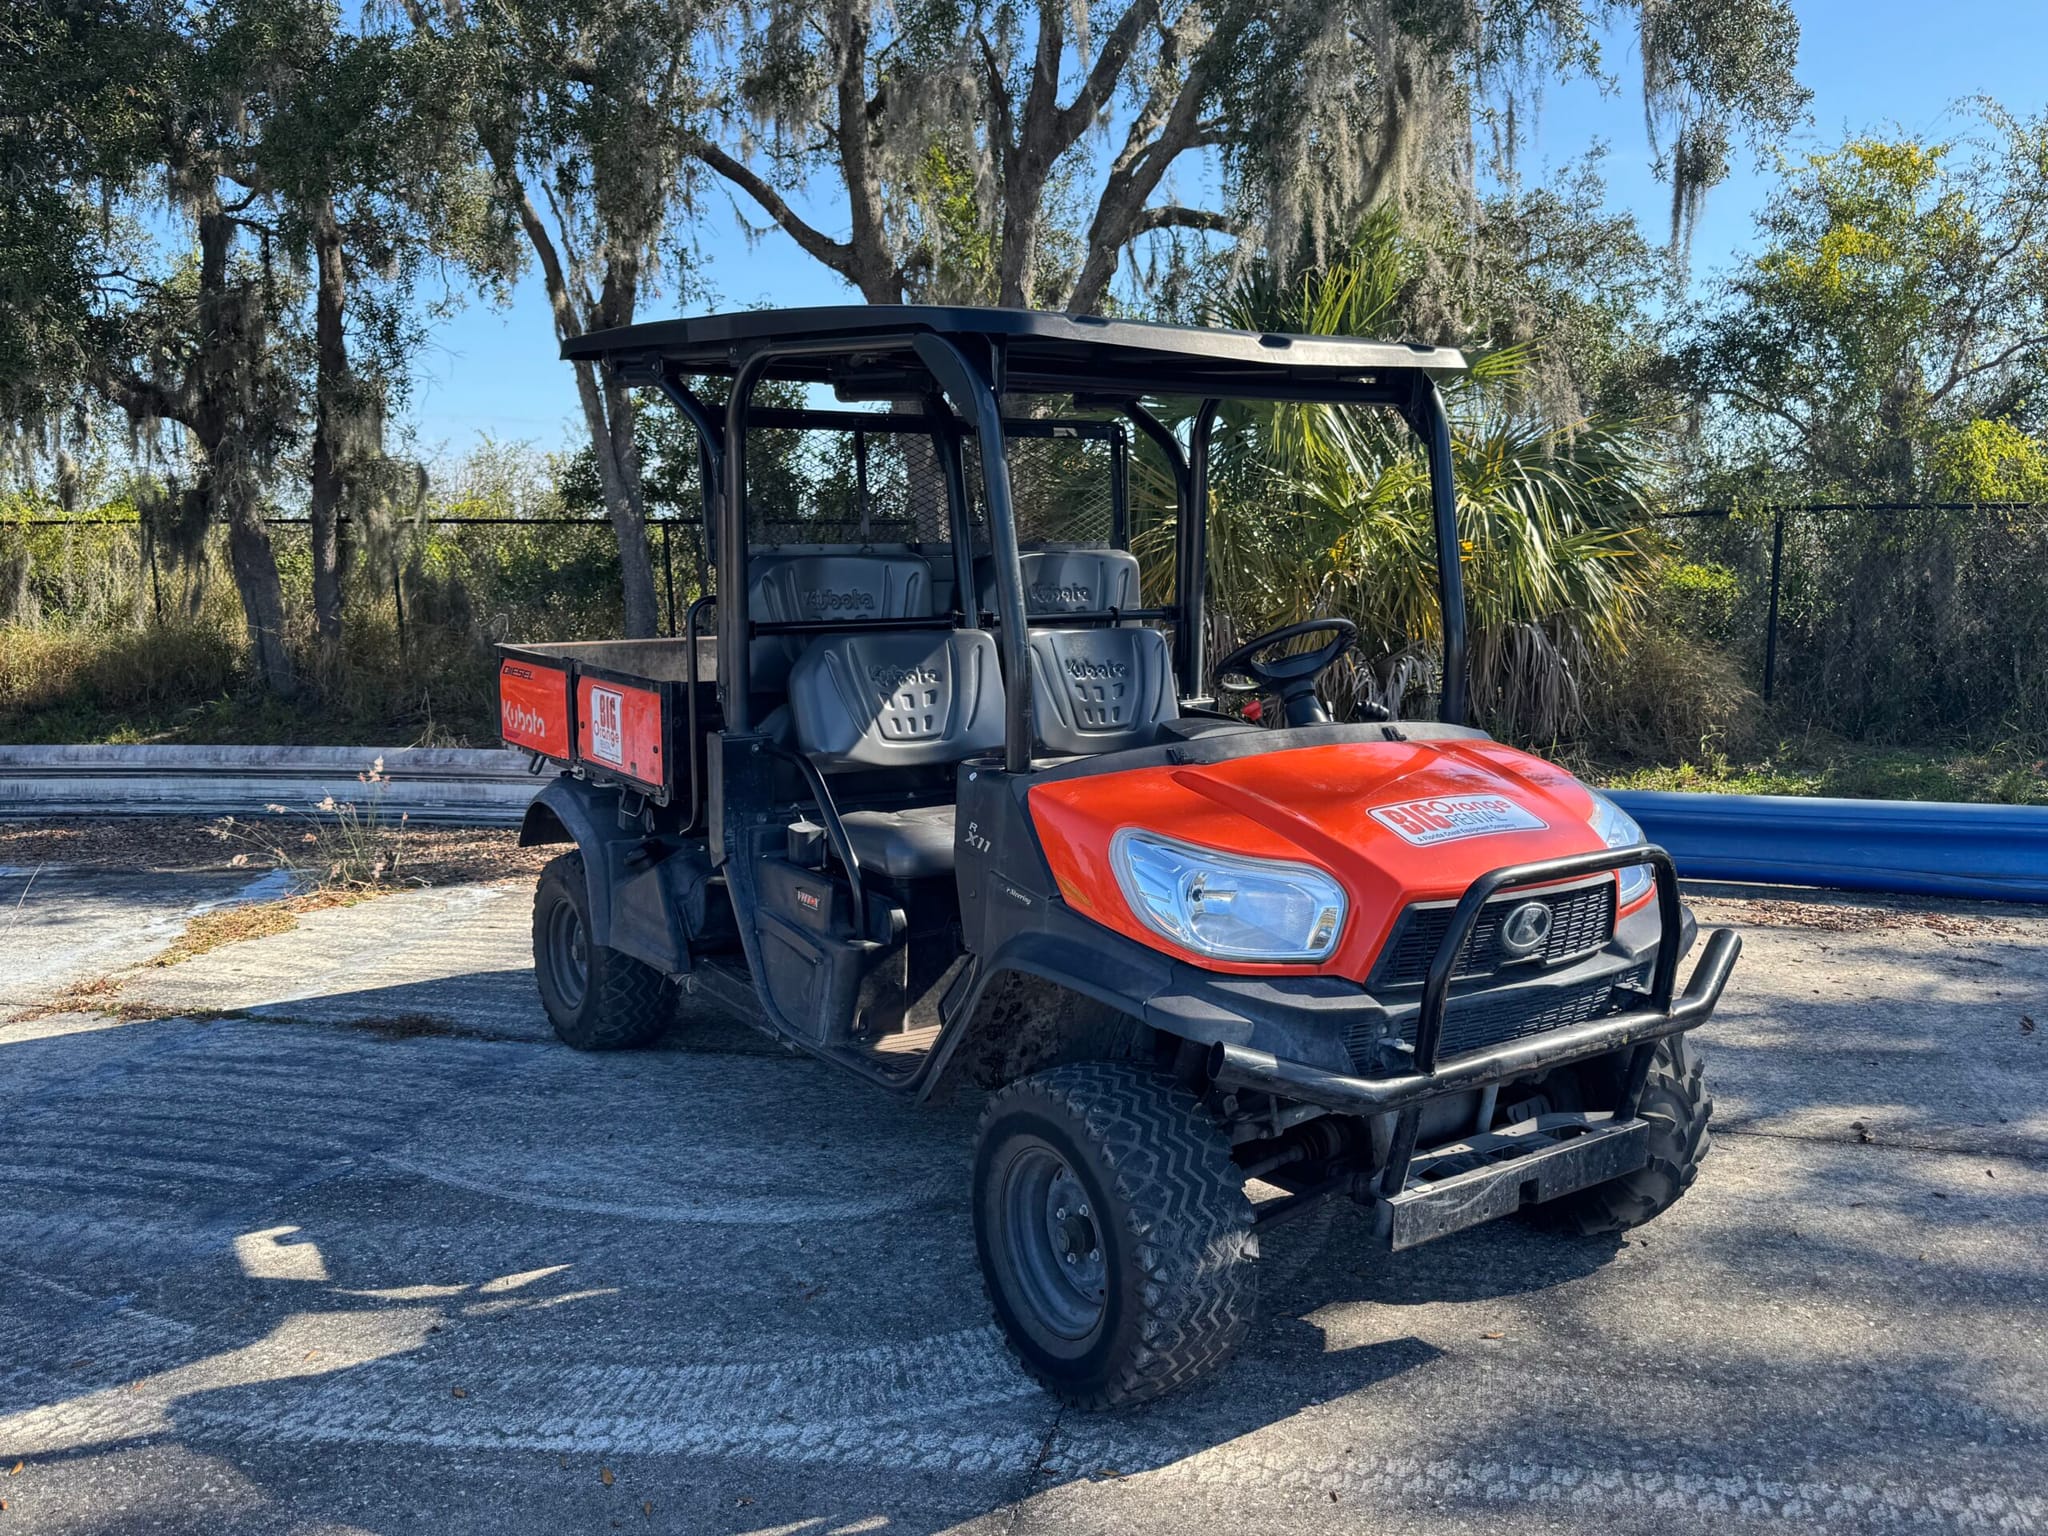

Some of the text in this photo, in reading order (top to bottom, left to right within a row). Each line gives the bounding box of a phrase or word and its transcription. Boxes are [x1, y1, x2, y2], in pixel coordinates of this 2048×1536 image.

[503, 665, 533, 680] DIESEL
[504, 700, 546, 738] Kubota
[600, 694, 616, 730] BIG
[593, 720, 619, 747] Orange
[1380, 799, 1511, 834] BIG Orange
[1445, 809, 1508, 827] RENTAL
